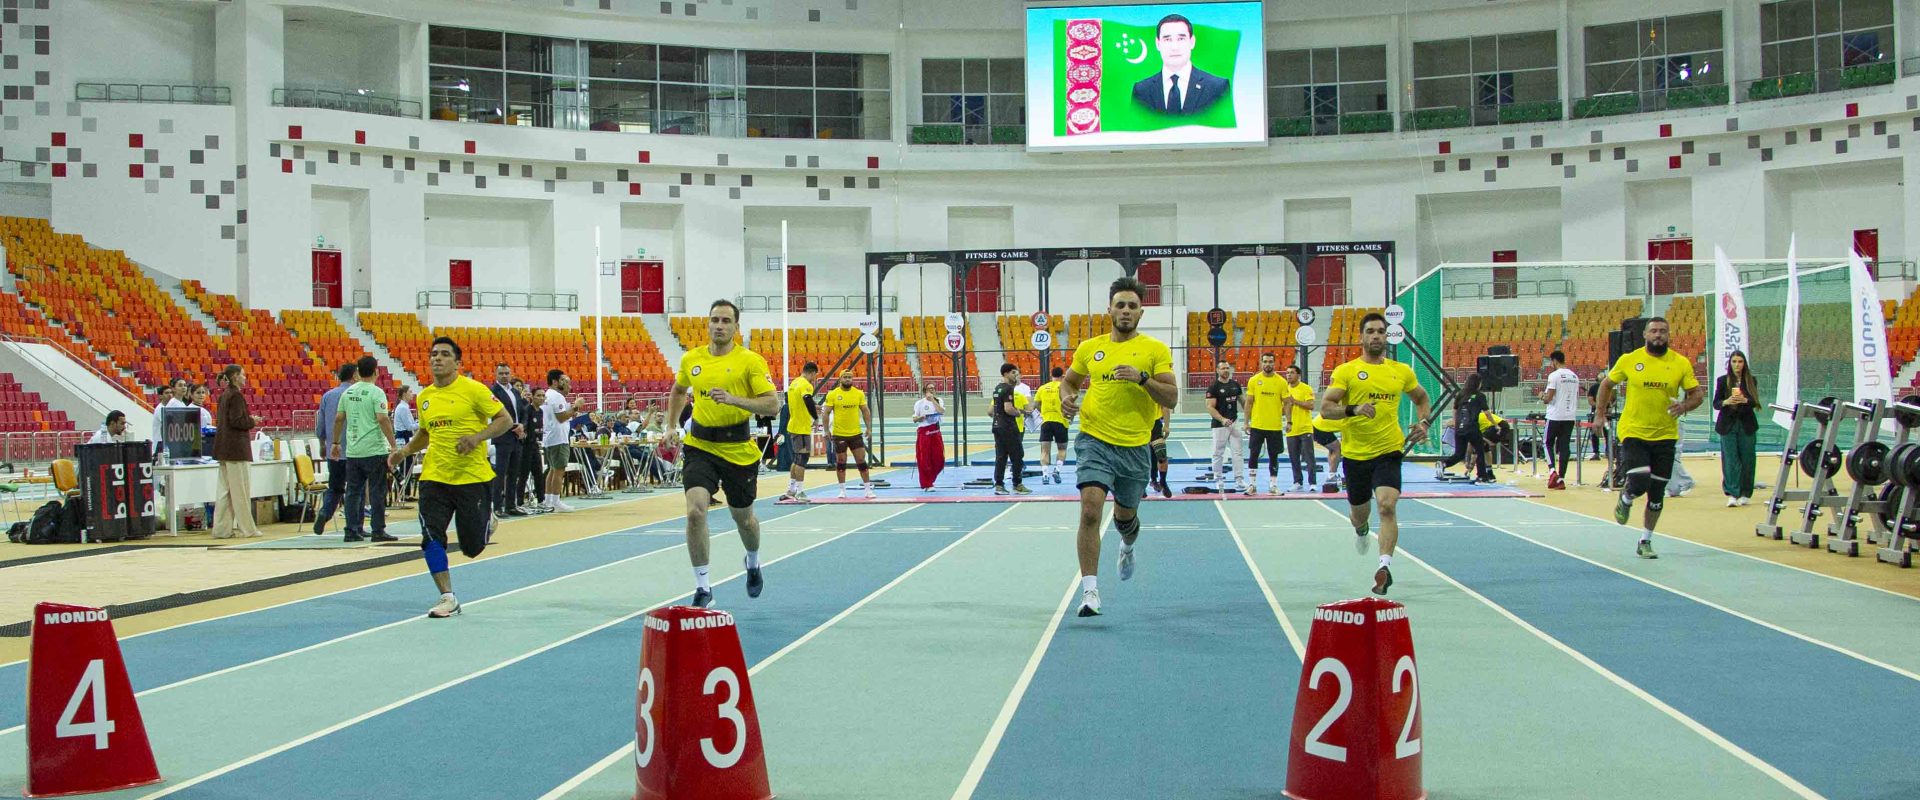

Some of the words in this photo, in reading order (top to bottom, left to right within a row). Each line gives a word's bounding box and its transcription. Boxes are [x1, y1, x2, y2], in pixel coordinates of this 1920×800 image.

[965, 251, 997, 259] FITNESS
[1001, 251, 1029, 259] GAMES
[1139, 247, 1172, 256] FITNESS
[1175, 247, 1204, 255] GAMES
[1316, 244, 1350, 252] FITNESS
[1353, 243, 1382, 251] GAMES
[1368, 392, 1396, 401] MAXFIT
[167, 423, 195, 442] 00:00
[429, 419, 454, 429] MAXFIT
[111, 463, 127, 519] bold
[139, 462, 155, 517] bold
[44, 610, 108, 625] MONDO
[680, 613, 735, 631] MONDO
[1314, 607, 1365, 626] MONDO
[56, 658, 115, 750] 4
[1305, 657, 1353, 762] 2
[1392, 655, 1421, 759] 2
[635, 667, 655, 768] 3
[700, 666, 747, 769] 3
